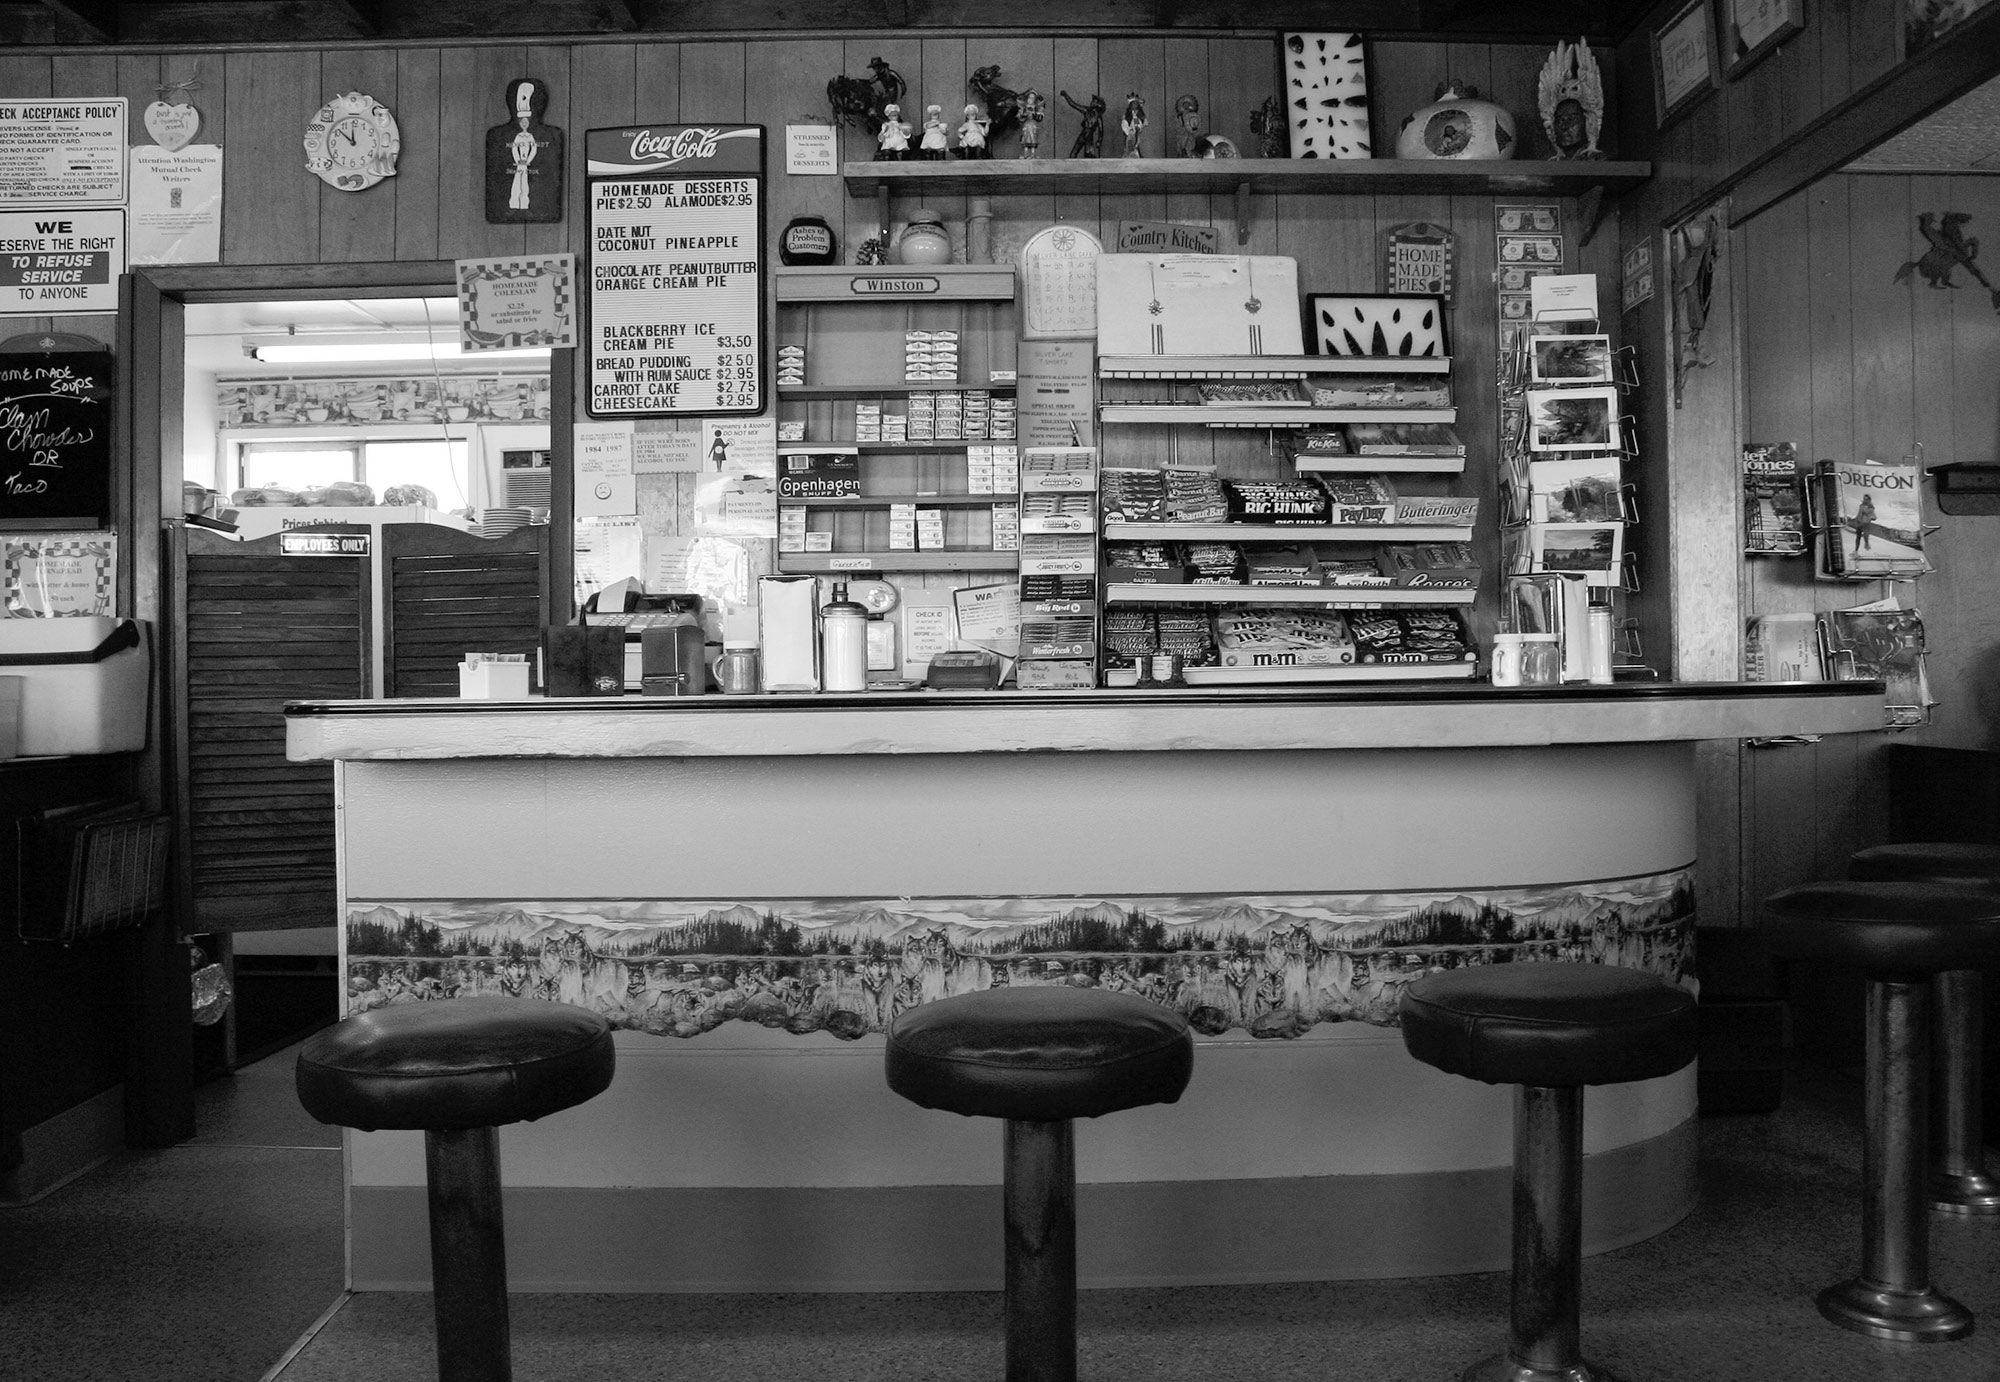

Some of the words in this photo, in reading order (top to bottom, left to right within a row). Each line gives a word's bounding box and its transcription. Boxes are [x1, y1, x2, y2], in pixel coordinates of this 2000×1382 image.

[22, 107, 81, 120] ACCEPTANCE
[85, 106, 118, 118] POLICY
[630, 128, 721, 161] Coca-Cola
[173, 157, 217, 165] Washington
[602, 183, 675, 197] HOMEMADE
[685, 181, 749, 194] DESSERTS
[35, 221, 73, 234] WE
[597, 226, 626, 239] DATE
[631, 226, 652, 238] NUT
[792, 227, 816, 235] Ashes
[0, 238, 45, 251] ESERVE
[52, 238, 75, 250] THE
[80, 237, 115, 249] RIGHT
[598, 239, 656, 252] COCONUT
[666, 236, 738, 249] PINEAPPLE
[792, 234, 825, 242] Problem
[1121, 230, 1168, 249] Country
[1171, 228, 1215, 255] Kitchen
[788, 242, 828, 251] Customers
[12, 256, 31, 268] TO
[36, 255, 93, 267] REFUSE
[1399, 249, 1443, 263] HOME
[21, 270, 83, 283] SERVICE
[595, 264, 662, 278] CHOCOLATE
[669, 262, 757, 276] PEANUTBUTTER
[1399, 263, 1441, 278] MADE
[492, 281, 538, 290] HOMEMADE
[595, 278, 646, 291] ORANGE
[653, 276, 698, 289] CREAM
[706, 275, 727, 288] PIE
[867, 280, 924, 291] Winston
[1398, 278, 1427, 292] PIES
[19, 288, 35, 300] TO
[40, 287, 88, 299] ANYONE
[494, 288, 537, 297] COLESLAW
[500, 310, 530, 318] substitute
[532, 308, 541, 316] for
[603, 324, 686, 338] BLACKBERRY
[695, 323, 716, 335] ICE
[603, 338, 647, 351] CREAM
[654, 338, 675, 350] PIE
[716, 335, 752, 348] $3.50
[596, 357, 634, 370] BREAD
[639, 356, 691, 369] PUDDING
[36, 366, 75, 379] MADE
[614, 370, 644, 383] WITH
[647, 369, 672, 382] RUM
[675, 369, 712, 381] SAUCE
[716, 367, 754, 380] $2.95
[50, 377, 94, 394] SOUPS
[594, 383, 641, 397] CARROT
[649, 382, 680, 395] CAKE
[716, 380, 756, 393] $2.75
[594, 396, 677, 410] CHEESECAKE
[716, 394, 753, 407] $2.95
[0, 404, 50, 429] Clam
[7, 424, 94, 452] Chowder
[33, 449, 60, 465] OR
[5, 471, 48, 494] Taco
[779, 477, 860, 497] Copenhagen
[1840, 471, 1914, 489] OREGON
[1177, 507, 1209, 521] Peanut
[1209, 506, 1226, 517] Bar
[1341, 506, 1386, 522] PayDay
[1399, 503, 1477, 520] Butterfinger
[282, 518, 311, 529] Prices
[284, 538, 340, 552] EMPLOYEES
[341, 538, 365, 552] ONLY
[1035, 604, 1051, 612] Big
[1052, 604, 1070, 612] Red
[1032, 644, 1071, 656] Winterfresh
